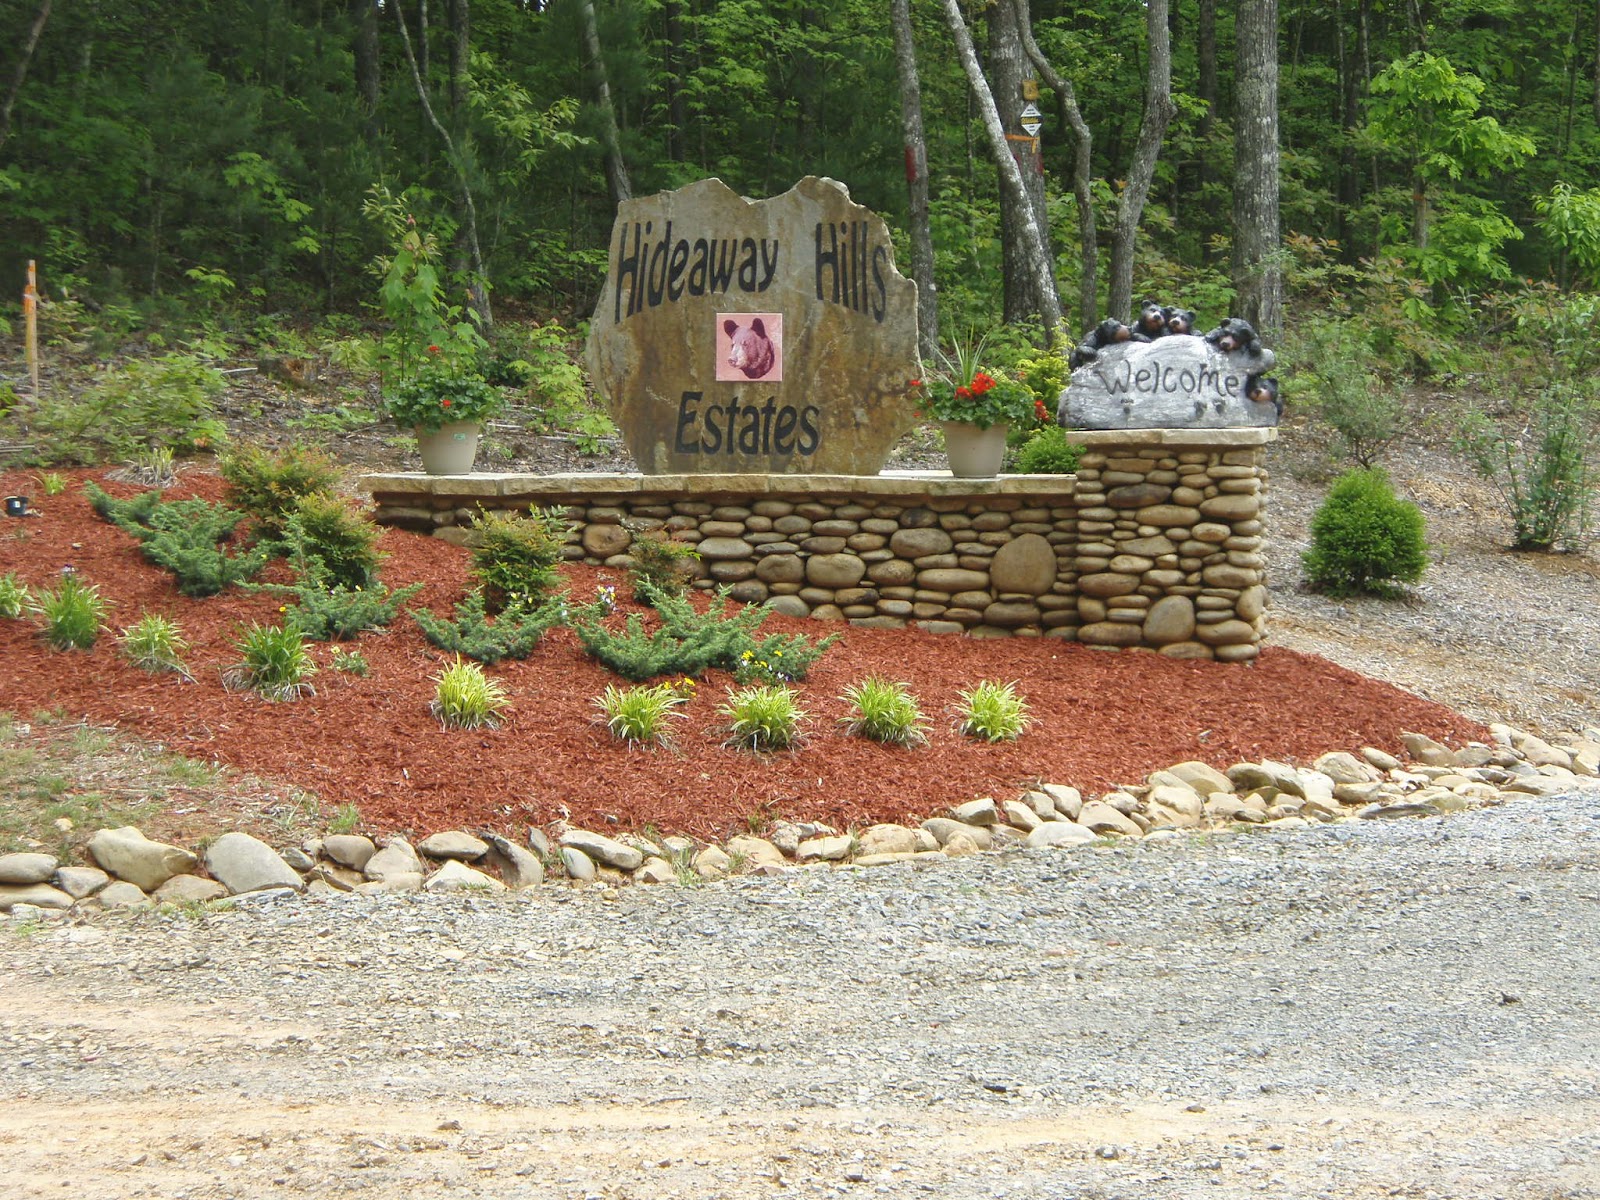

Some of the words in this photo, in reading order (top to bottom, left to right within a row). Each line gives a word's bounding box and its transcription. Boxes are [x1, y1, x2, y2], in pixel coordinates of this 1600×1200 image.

[615, 221, 779, 324] Hideaway
[815, 221, 887, 323] Hills
[1094, 359, 1239, 397] Welcome
[675, 391, 820, 456] Estates
